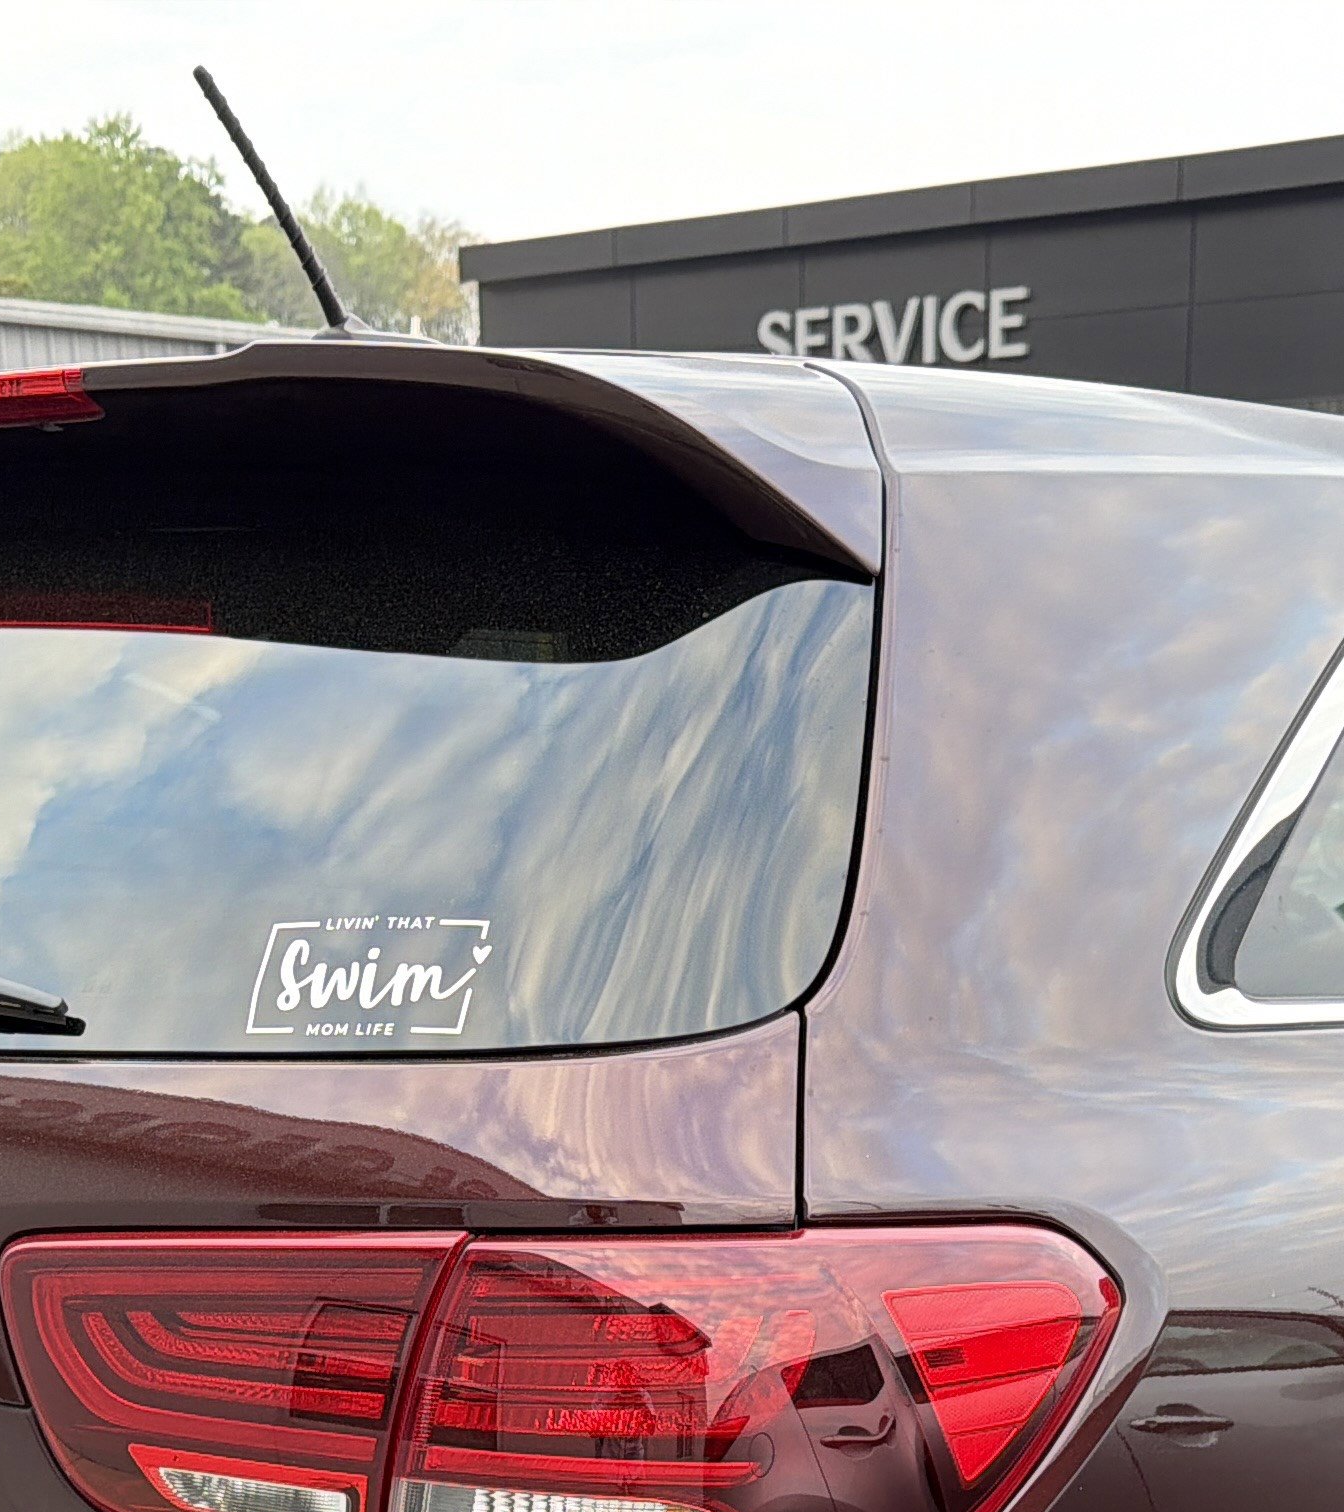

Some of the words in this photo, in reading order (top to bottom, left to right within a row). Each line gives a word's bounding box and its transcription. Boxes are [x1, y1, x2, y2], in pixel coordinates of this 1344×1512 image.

[757, 285, 1031, 365] SERVICE
[325, 915, 380, 931] LIVIN'
[387, 916, 436, 930] THAT
[276, 938, 477, 1011] Swim
[305, 1023, 348, 1036] MOM
[354, 1023, 395, 1036] LIFE
